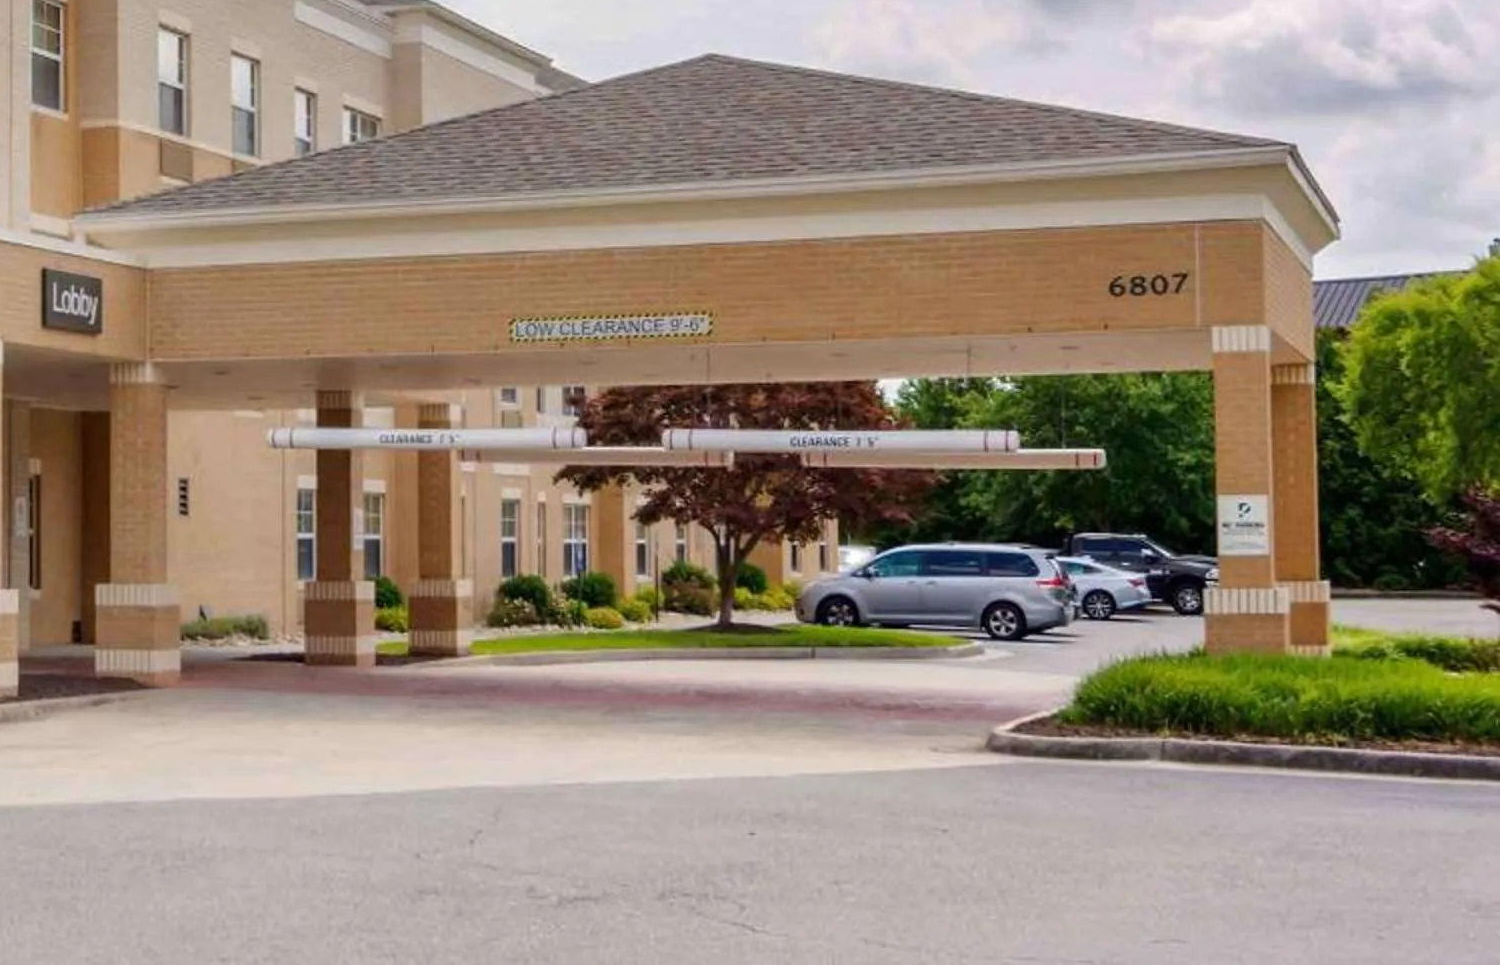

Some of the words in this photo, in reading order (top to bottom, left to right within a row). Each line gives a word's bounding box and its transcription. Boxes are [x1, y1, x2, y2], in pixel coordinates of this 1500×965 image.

[1109, 273, 1188, 297] 6807
[53, 282, 99, 325] Lobby
[515, 321, 555, 337] LOW
[559, 318, 666, 336] CLEARANCE
[789, 436, 851, 447] CLEARANCE
